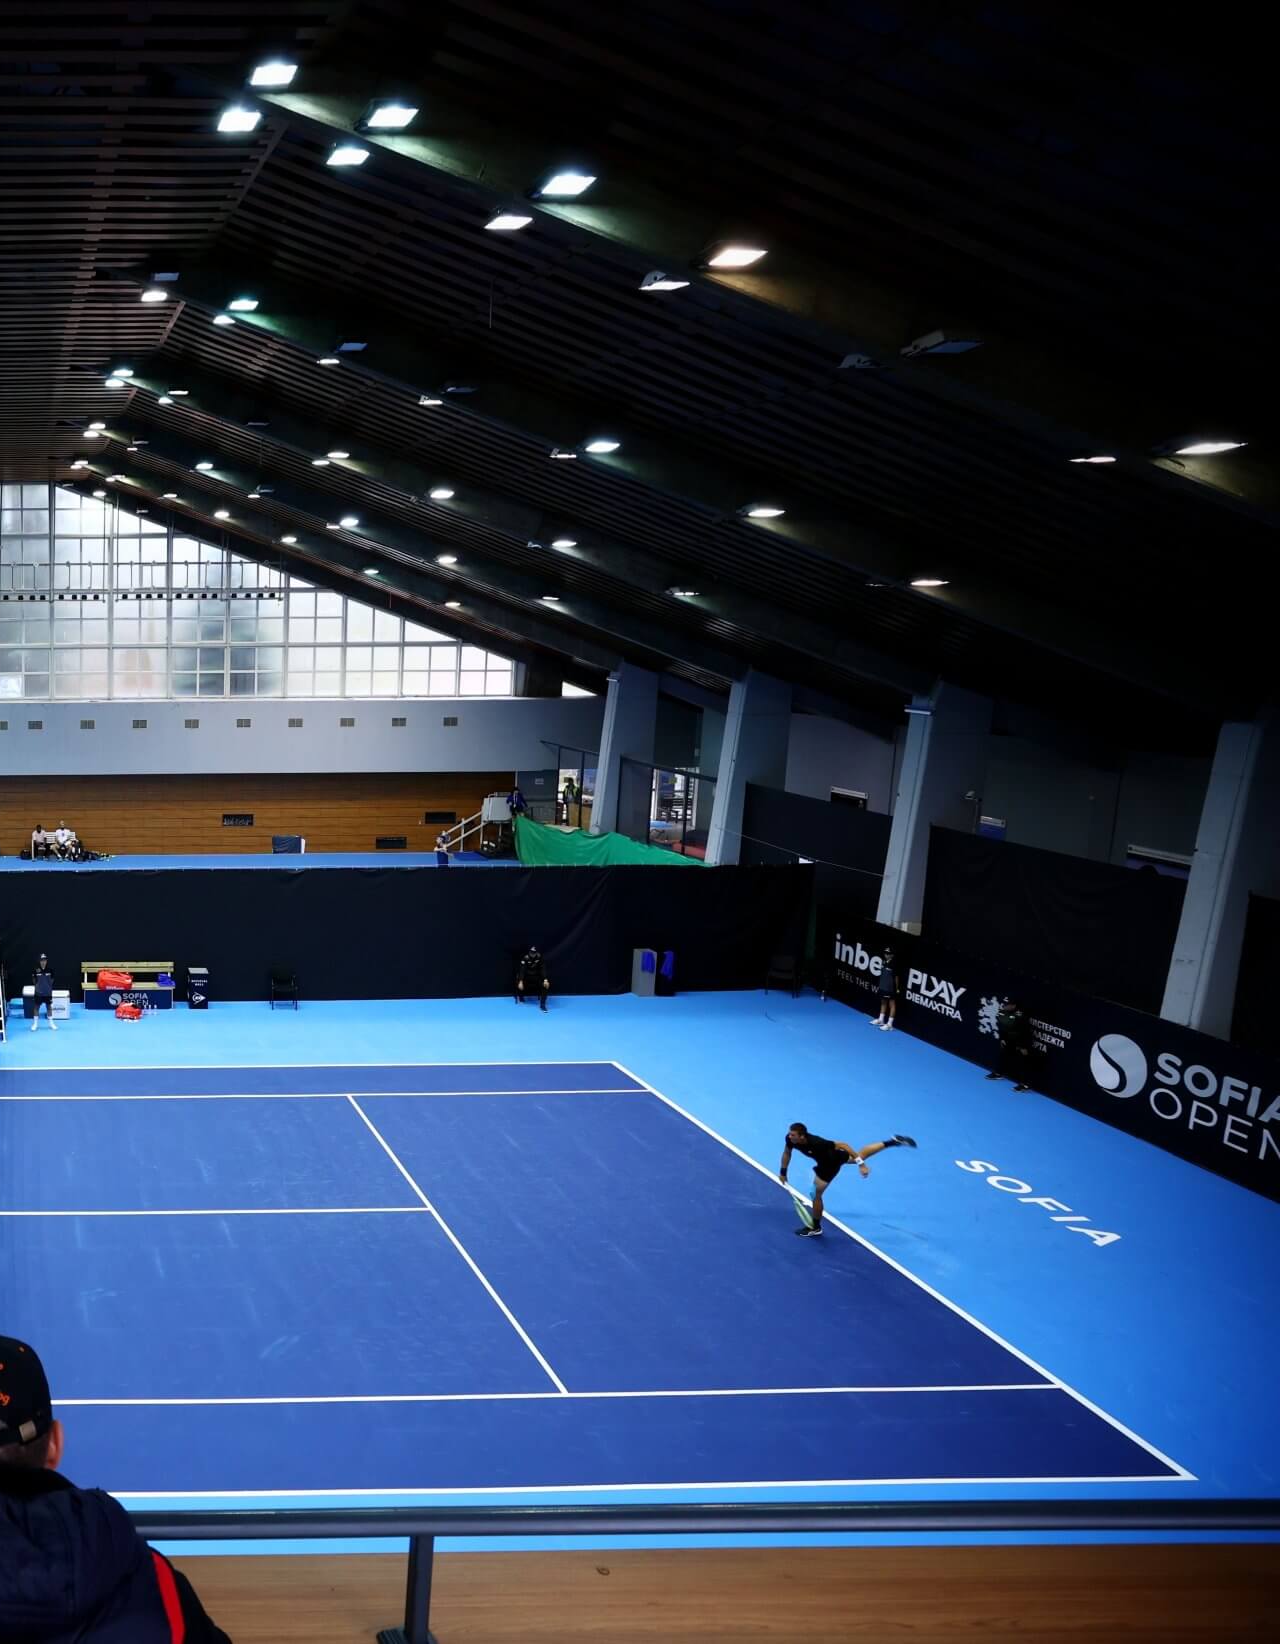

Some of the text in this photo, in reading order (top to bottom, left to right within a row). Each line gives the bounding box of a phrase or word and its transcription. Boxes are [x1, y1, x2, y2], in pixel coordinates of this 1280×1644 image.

[834, 932, 883, 977] inbe
[1154, 1052, 1280, 1123] SOFIA
[954, 1160, 1121, 1247] SOFIA
